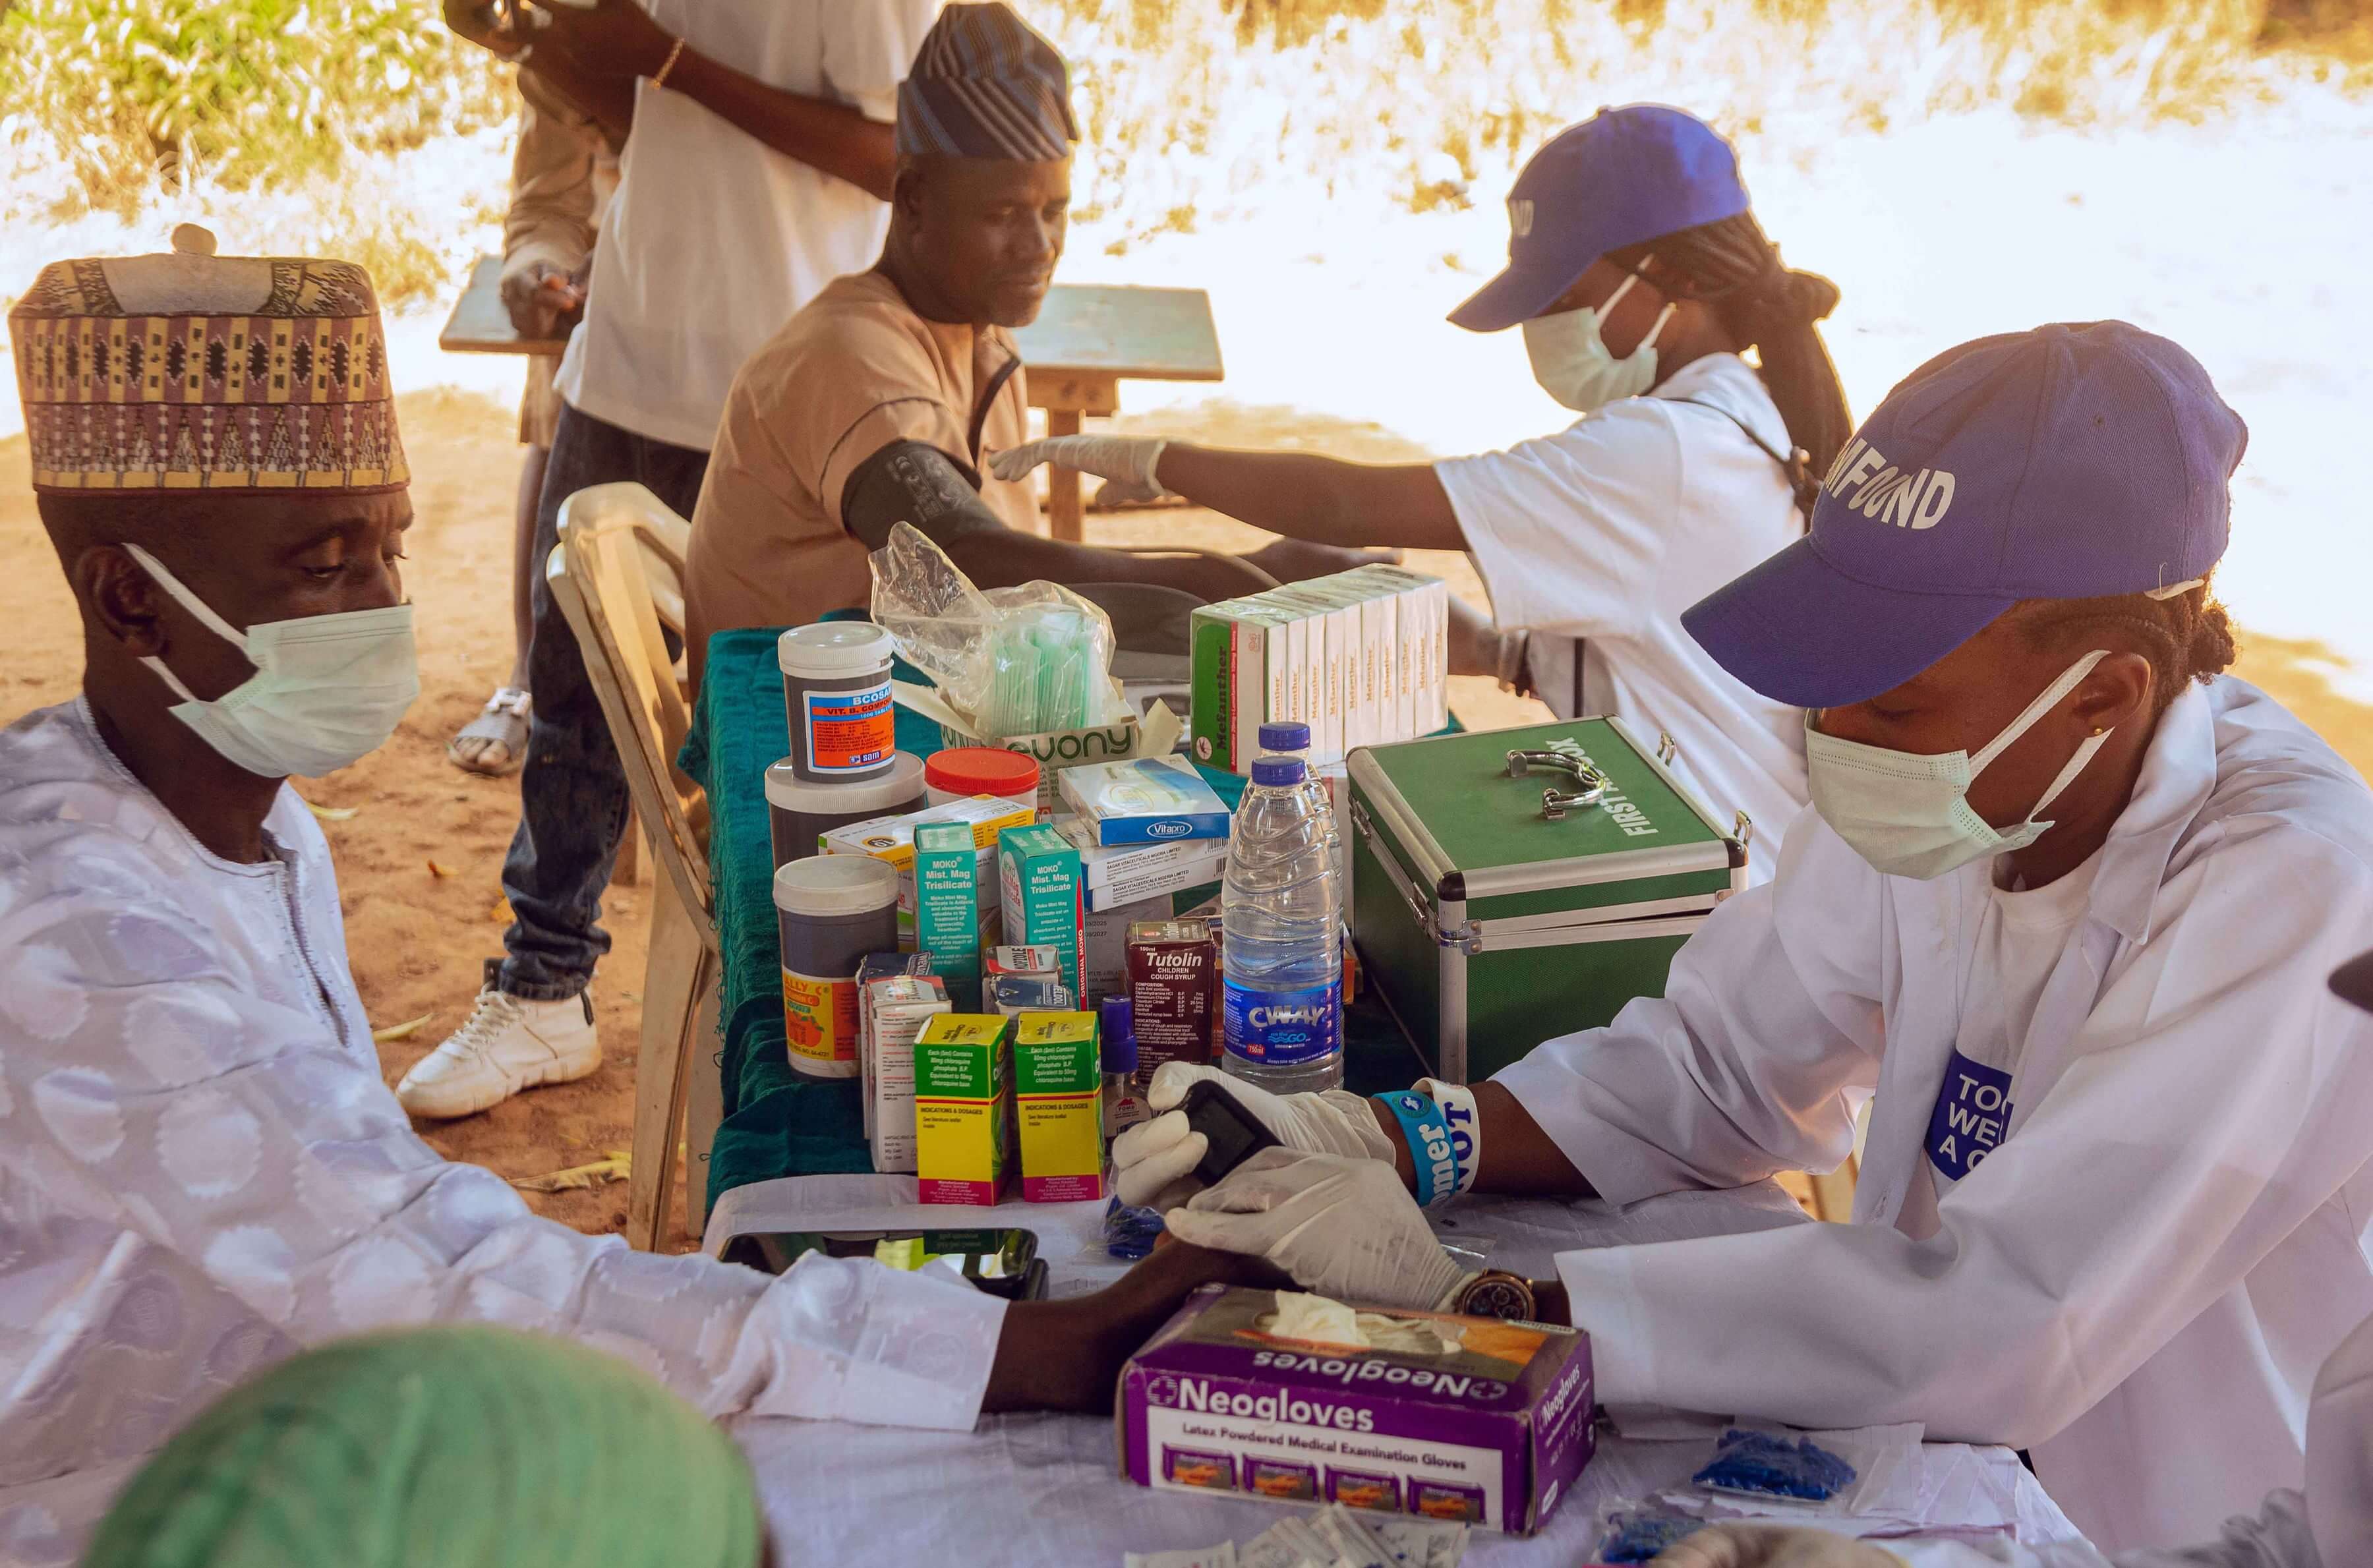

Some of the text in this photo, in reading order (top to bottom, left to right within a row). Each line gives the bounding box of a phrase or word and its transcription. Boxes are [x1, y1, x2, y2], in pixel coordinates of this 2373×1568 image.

[1216, 645, 1227, 751] Mefanther
[862, 751, 879, 762] sam
[1598, 796, 1659, 836] FIRST
[1154, 824, 1185, 834] Vitapro
[925, 870, 970, 879] Mist. Mag
[1031, 873, 1069, 885] Mist. Mag
[1173, 869, 1189, 878] LIMITED
[925, 881, 972, 890] Trisilicate
[1030, 883, 1071, 894] Trisilicate
[1147, 952, 1202, 967] Tutolin
[1248, 1005, 1326, 1028] CWAY
[1959, 1073, 2008, 1116] TO
[1254, 1350, 1472, 1397] Neogloves
[1542, 1363, 1581, 1422] Neogloves
[1179, 1378, 1375, 1433] Neogloves
[1182, 1422, 1467, 1471] Latex Powdered Medical Examination Gloves
